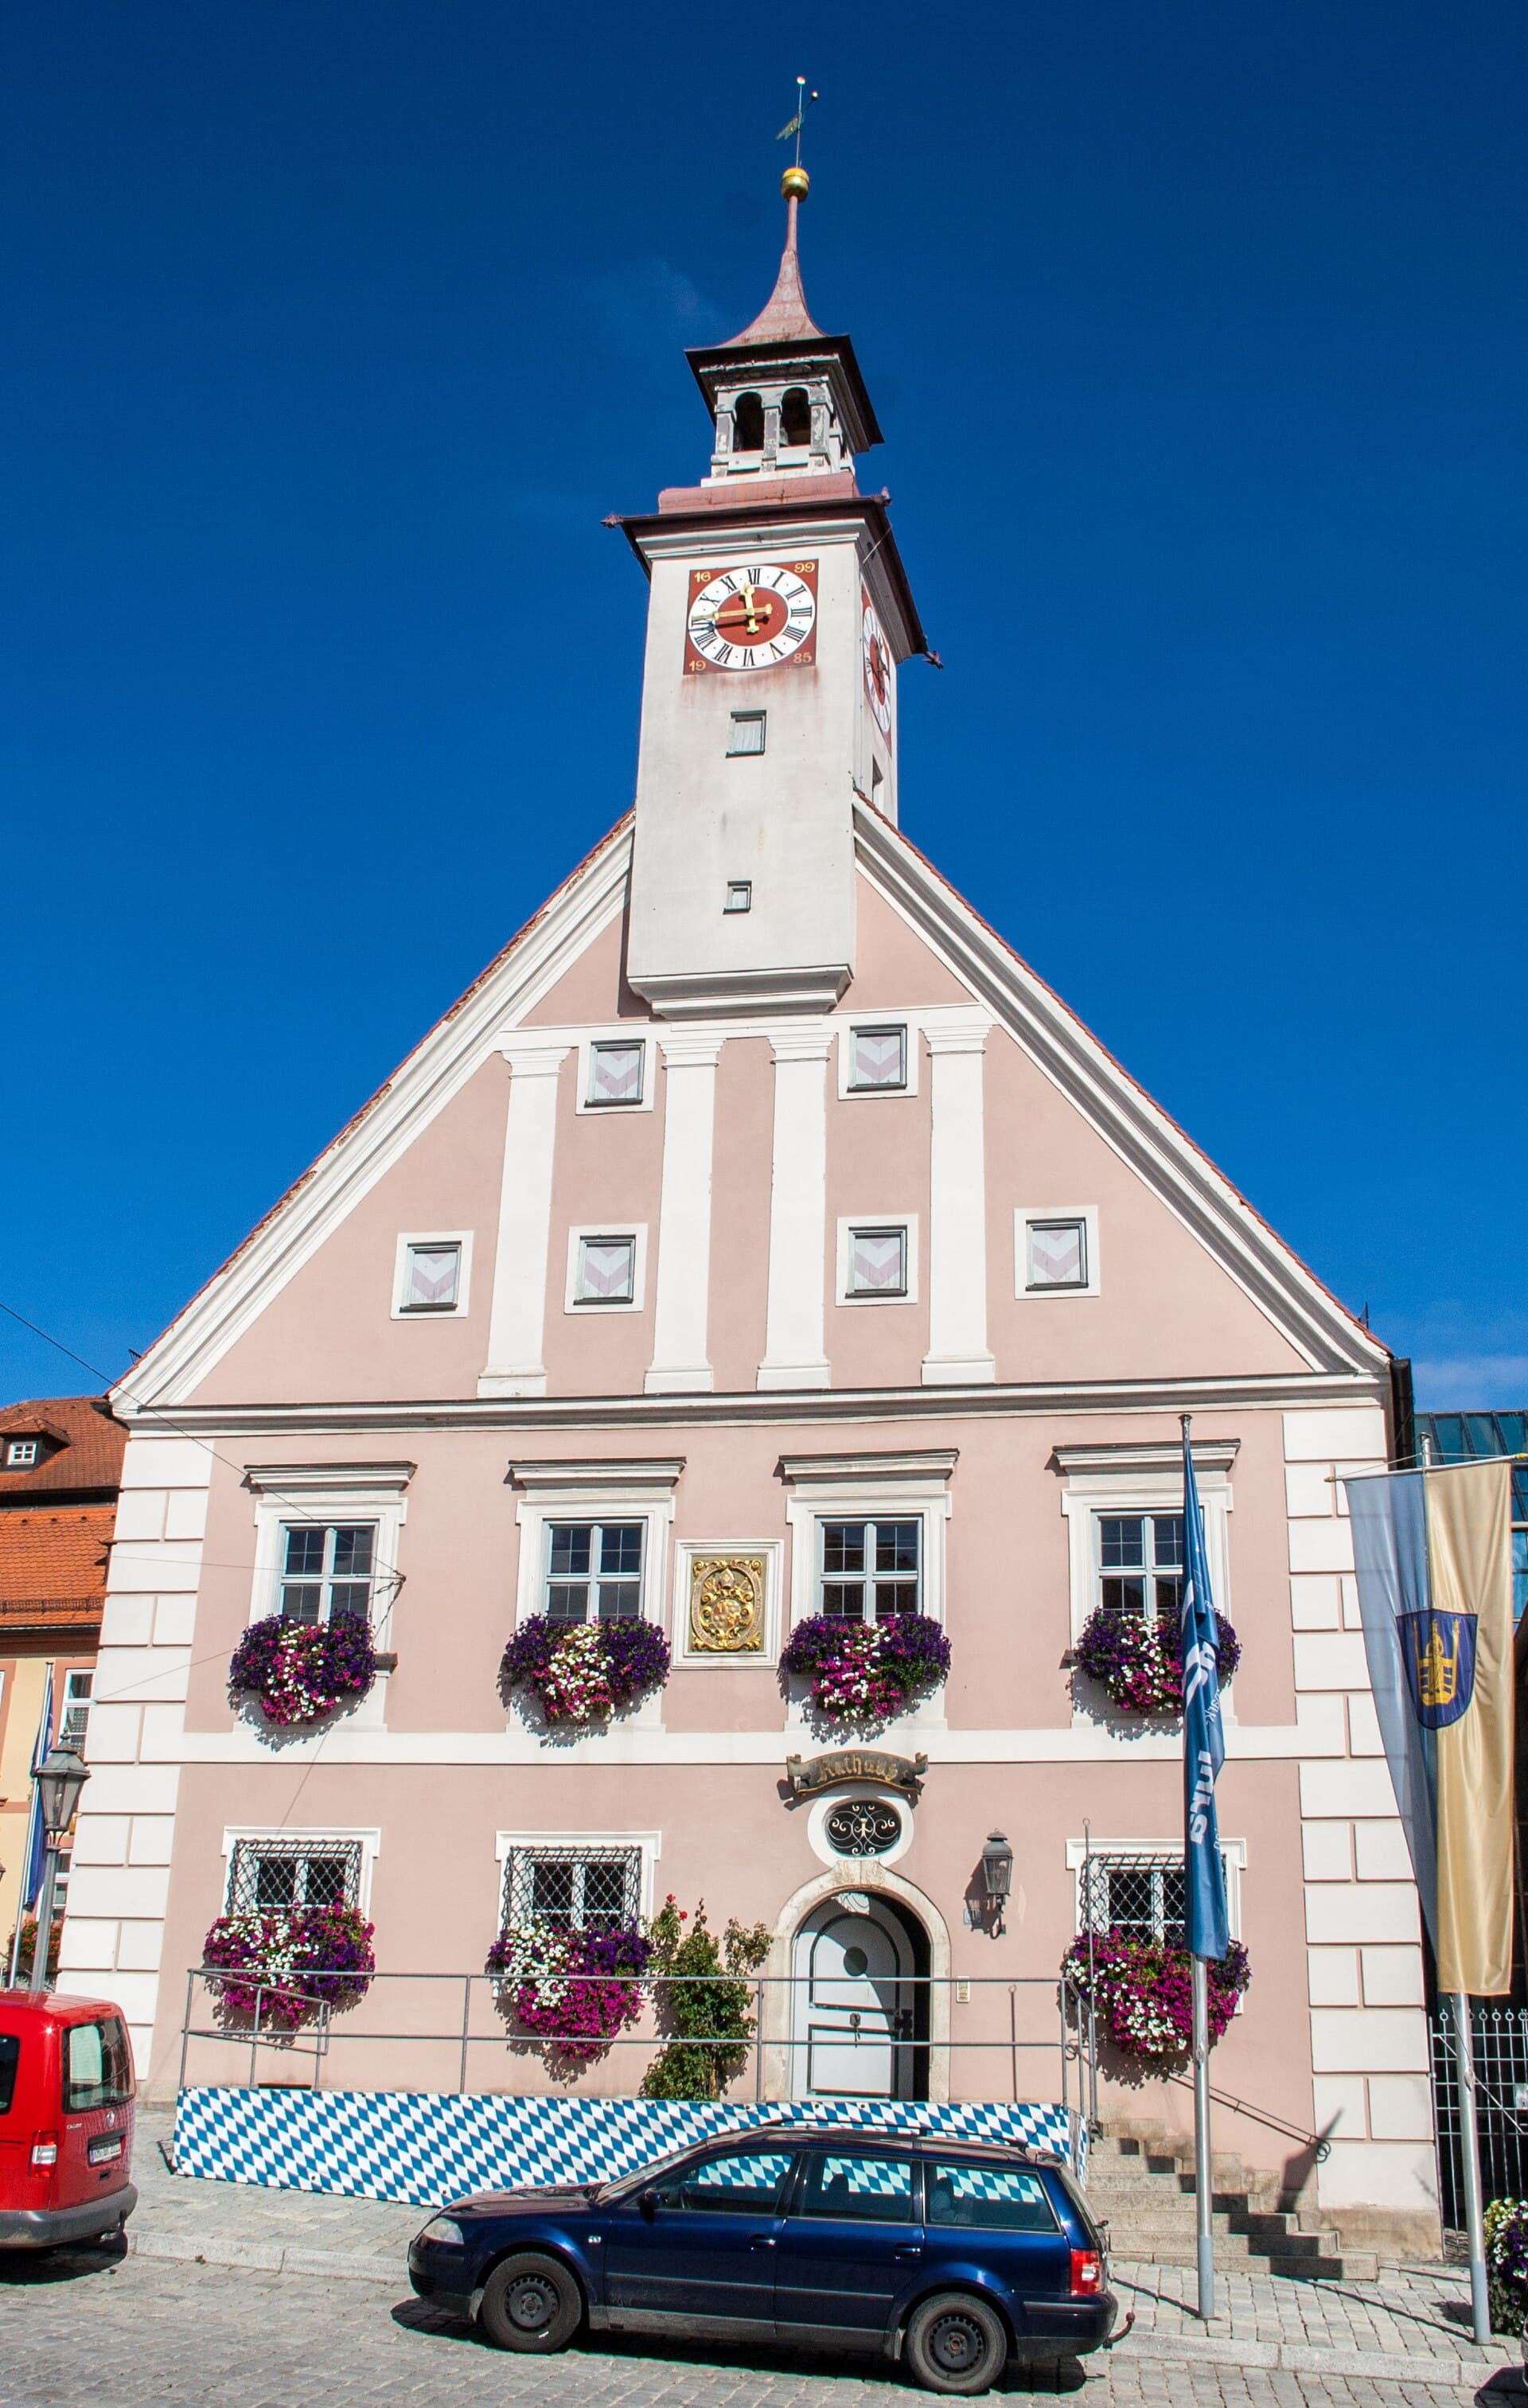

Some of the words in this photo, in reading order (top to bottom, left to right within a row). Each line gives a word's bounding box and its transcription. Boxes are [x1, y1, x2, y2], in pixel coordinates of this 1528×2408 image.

[794, 562, 815, 573] 99
[694, 571, 711, 583] 16
[719, 575, 738, 594] XI
[746, 568, 762, 585] XII
[772, 571, 786, 587] I
[698, 592, 721, 606] X
[784, 584, 808, 599] II
[790, 606, 813, 618] III
[693, 630, 717, 652] VIII
[782, 624, 808, 643] IIII
[711, 643, 734, 664] VII
[741, 648, 756, 667] VI
[769, 642, 786, 660] V
[793, 653, 813, 664] 85
[688, 660, 707, 672] 19
[815, 1753, 898, 1783] Rathaus
